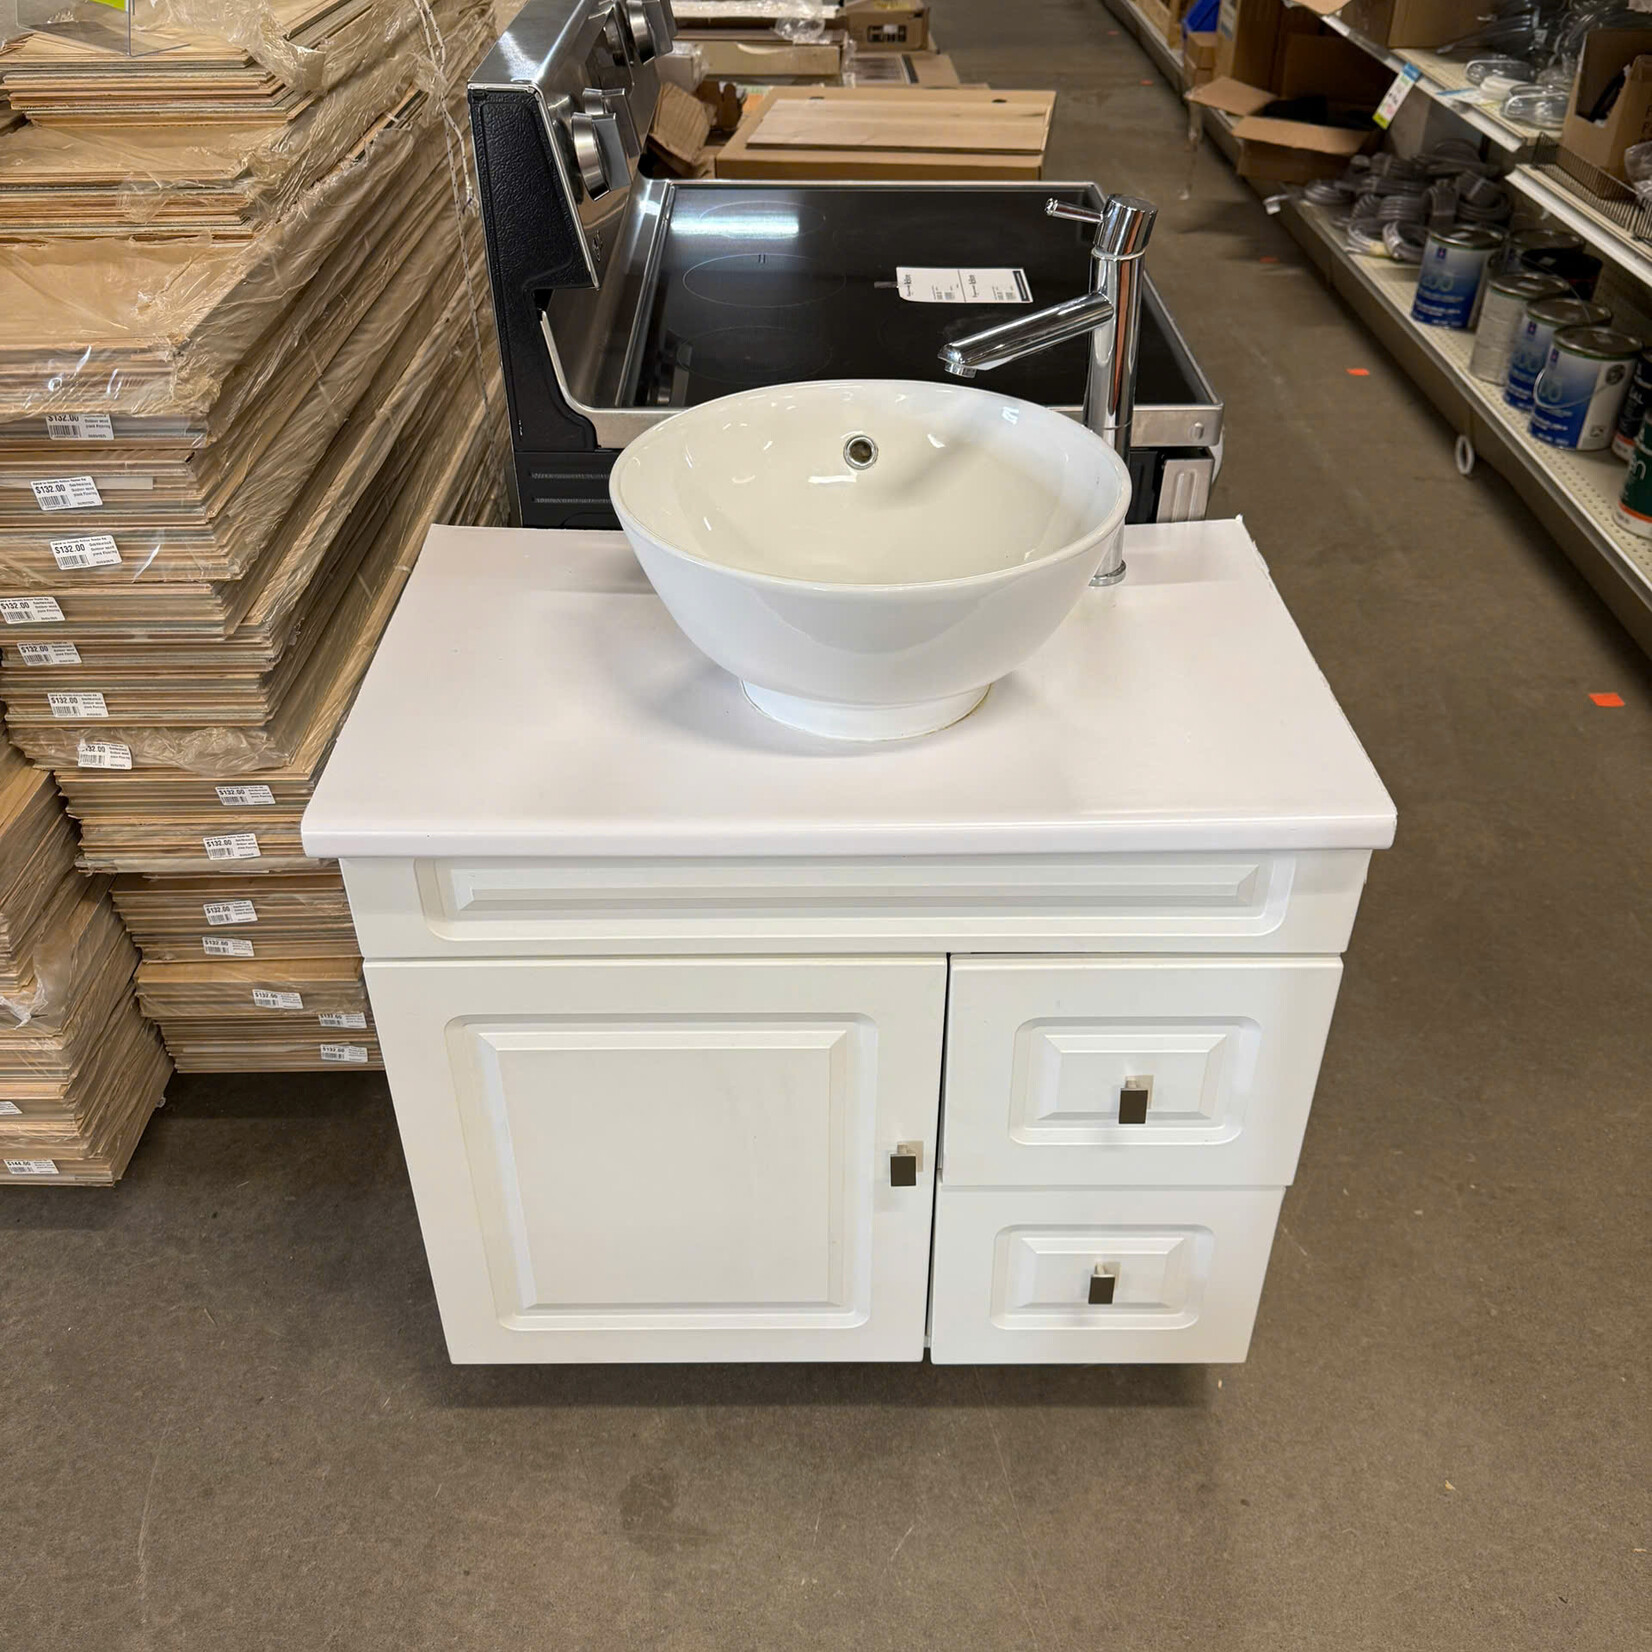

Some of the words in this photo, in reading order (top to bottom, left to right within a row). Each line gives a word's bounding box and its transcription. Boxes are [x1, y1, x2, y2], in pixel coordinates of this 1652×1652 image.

[35, 484, 66, 494] $132.00
[55, 543, 86, 554] $132.00
[0, 601, 30, 610] $132.00
[20, 645, 49, 653] $132.00
[50, 696, 79, 704] $132.00
[206, 839, 233, 847] $132.00
[206, 906, 231, 914] $132.00
